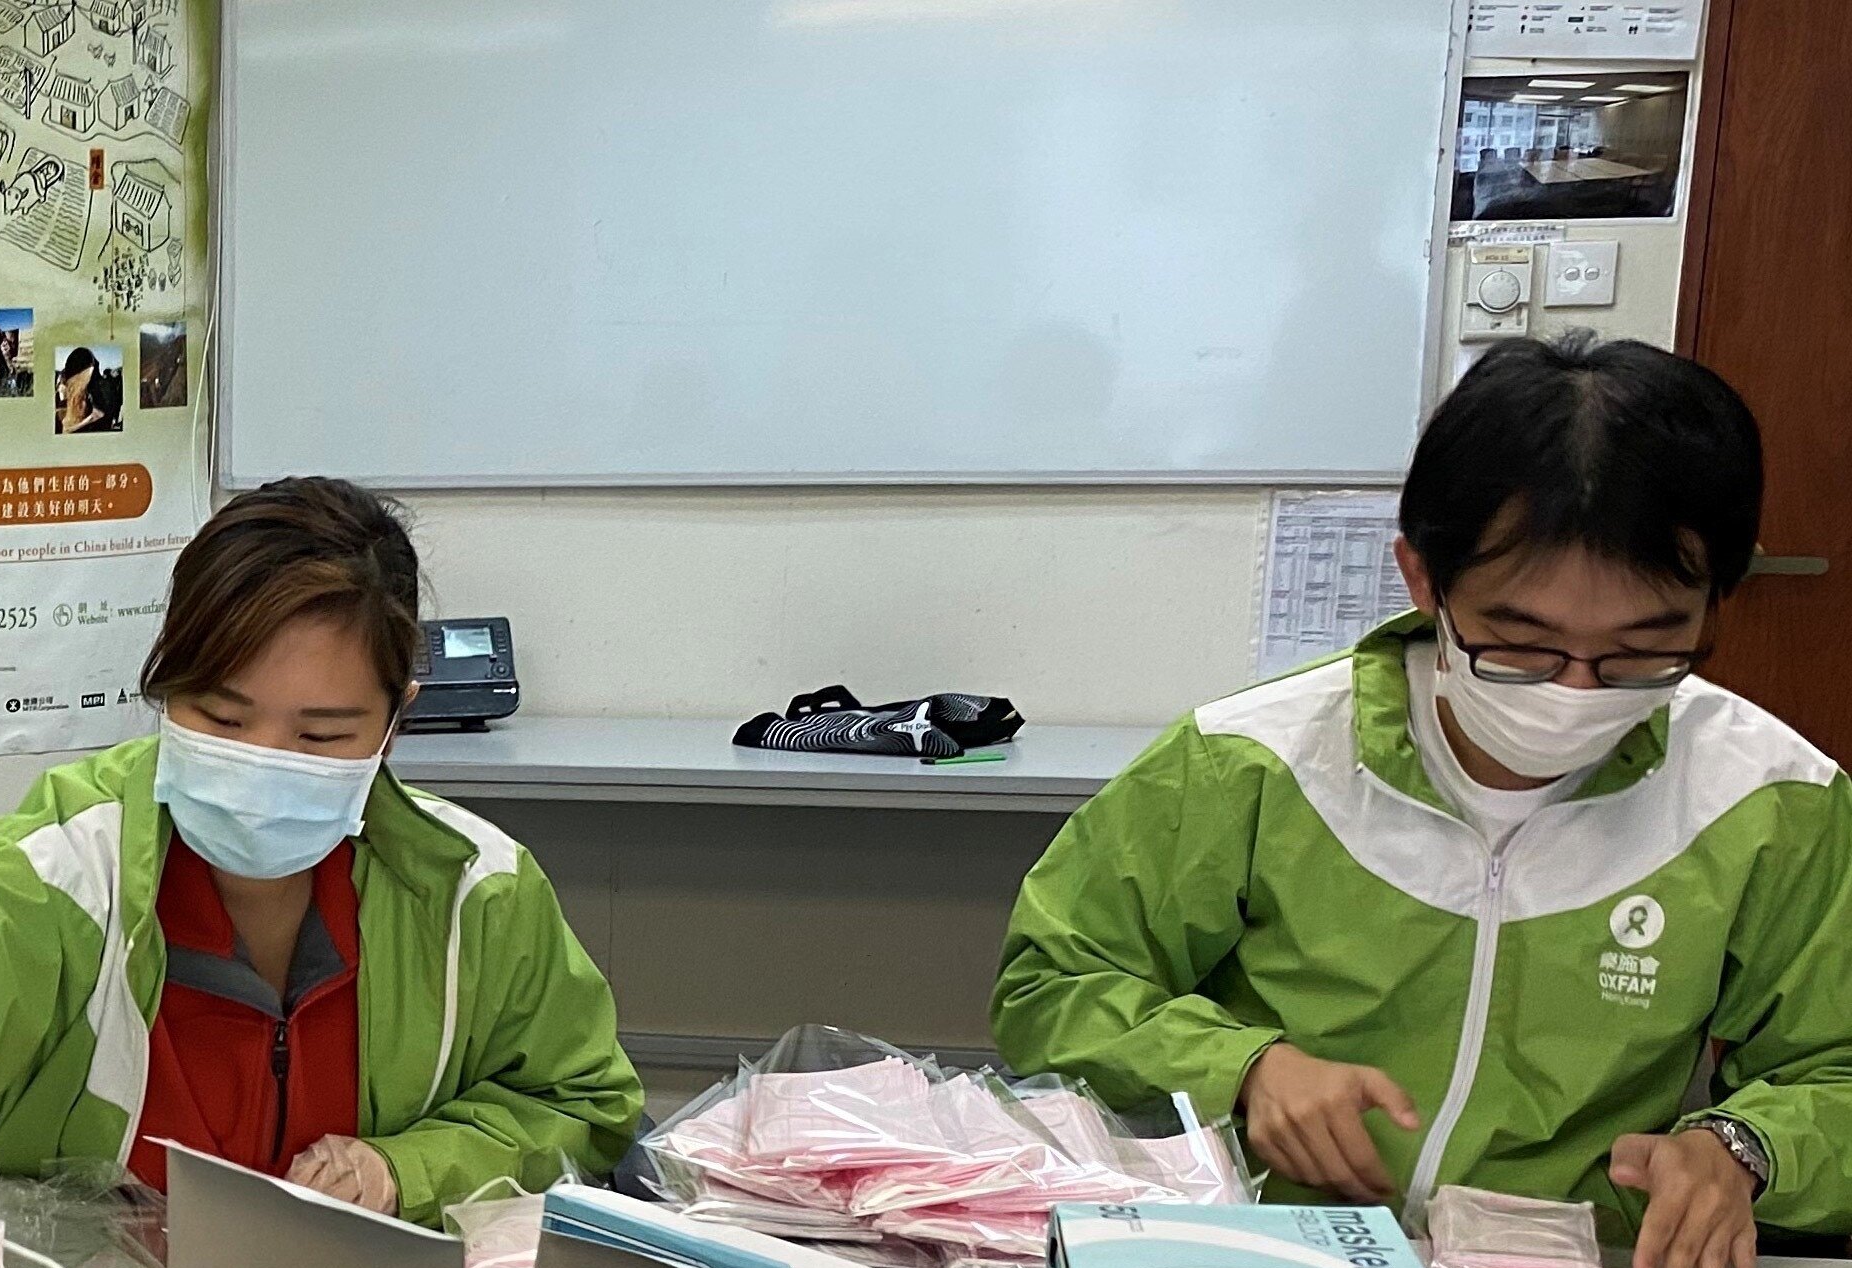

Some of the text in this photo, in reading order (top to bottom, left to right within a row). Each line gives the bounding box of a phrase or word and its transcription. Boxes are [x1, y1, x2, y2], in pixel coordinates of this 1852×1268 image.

[18, 544, 57, 560] people
[59, 543, 70, 553] in
[74, 540, 107, 553] China
[109, 538, 134, 551] build
[136, 541, 142, 549] a
[144, 536, 166, 548] better
[78, 613, 108, 626] Website
[1599, 971, 1656, 995] OXFAM
